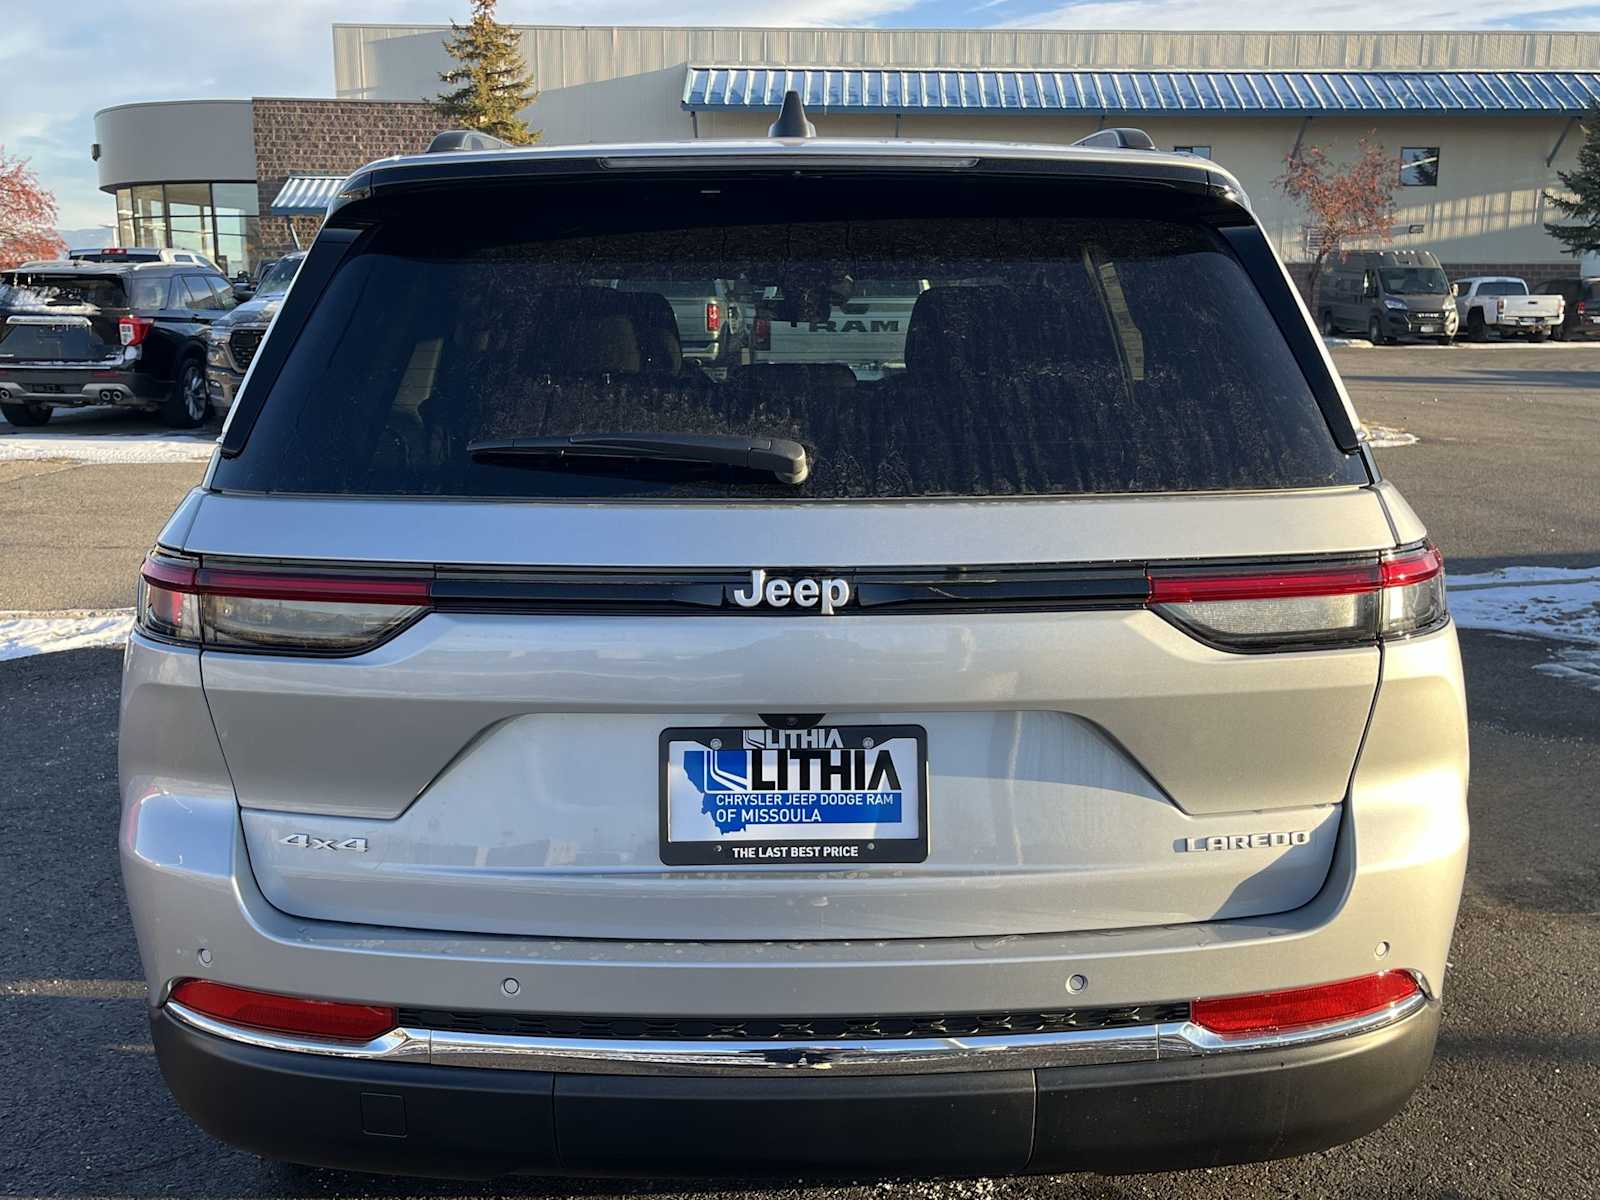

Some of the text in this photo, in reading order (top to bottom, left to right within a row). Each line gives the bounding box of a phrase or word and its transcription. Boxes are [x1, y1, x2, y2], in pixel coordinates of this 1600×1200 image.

[808, 320, 899, 332] RAM
[733, 569, 850, 615] Jeep
[765, 729, 844, 749] LITHIA
[751, 749, 902, 791] LITHIA
[716, 794, 893, 806] CHRYSLER JEEP DODGE RAM
[716, 808, 822, 823] OF MISSOULA
[281, 833, 368, 852] 4x4
[1186, 831, 1311, 852] LAREDO
[732, 846, 859, 858] THE LAST BEST PRICE
